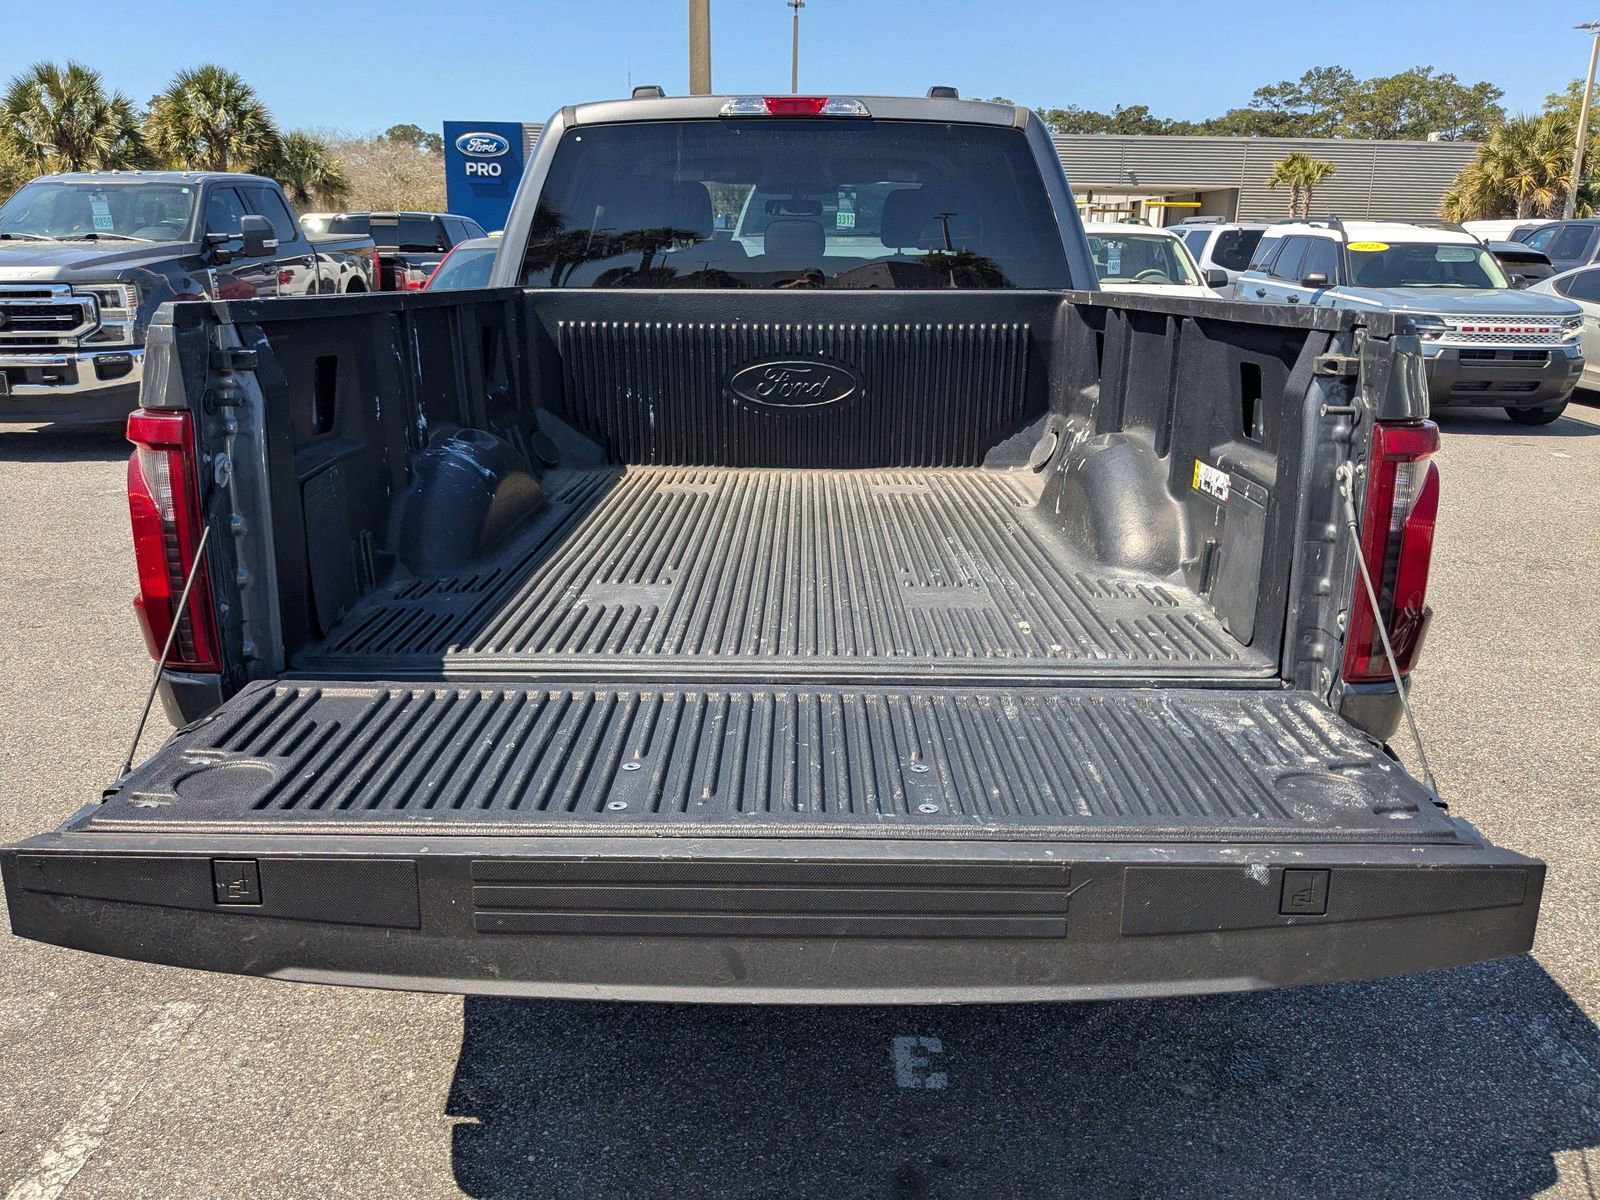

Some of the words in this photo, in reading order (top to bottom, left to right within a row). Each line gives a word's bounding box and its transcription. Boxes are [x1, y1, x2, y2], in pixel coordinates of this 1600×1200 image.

[466, 138, 497, 153] Ford
[465, 162, 502, 177] PRO
[837, 214, 854, 225] 3312
[756, 367, 831, 398] Ford
